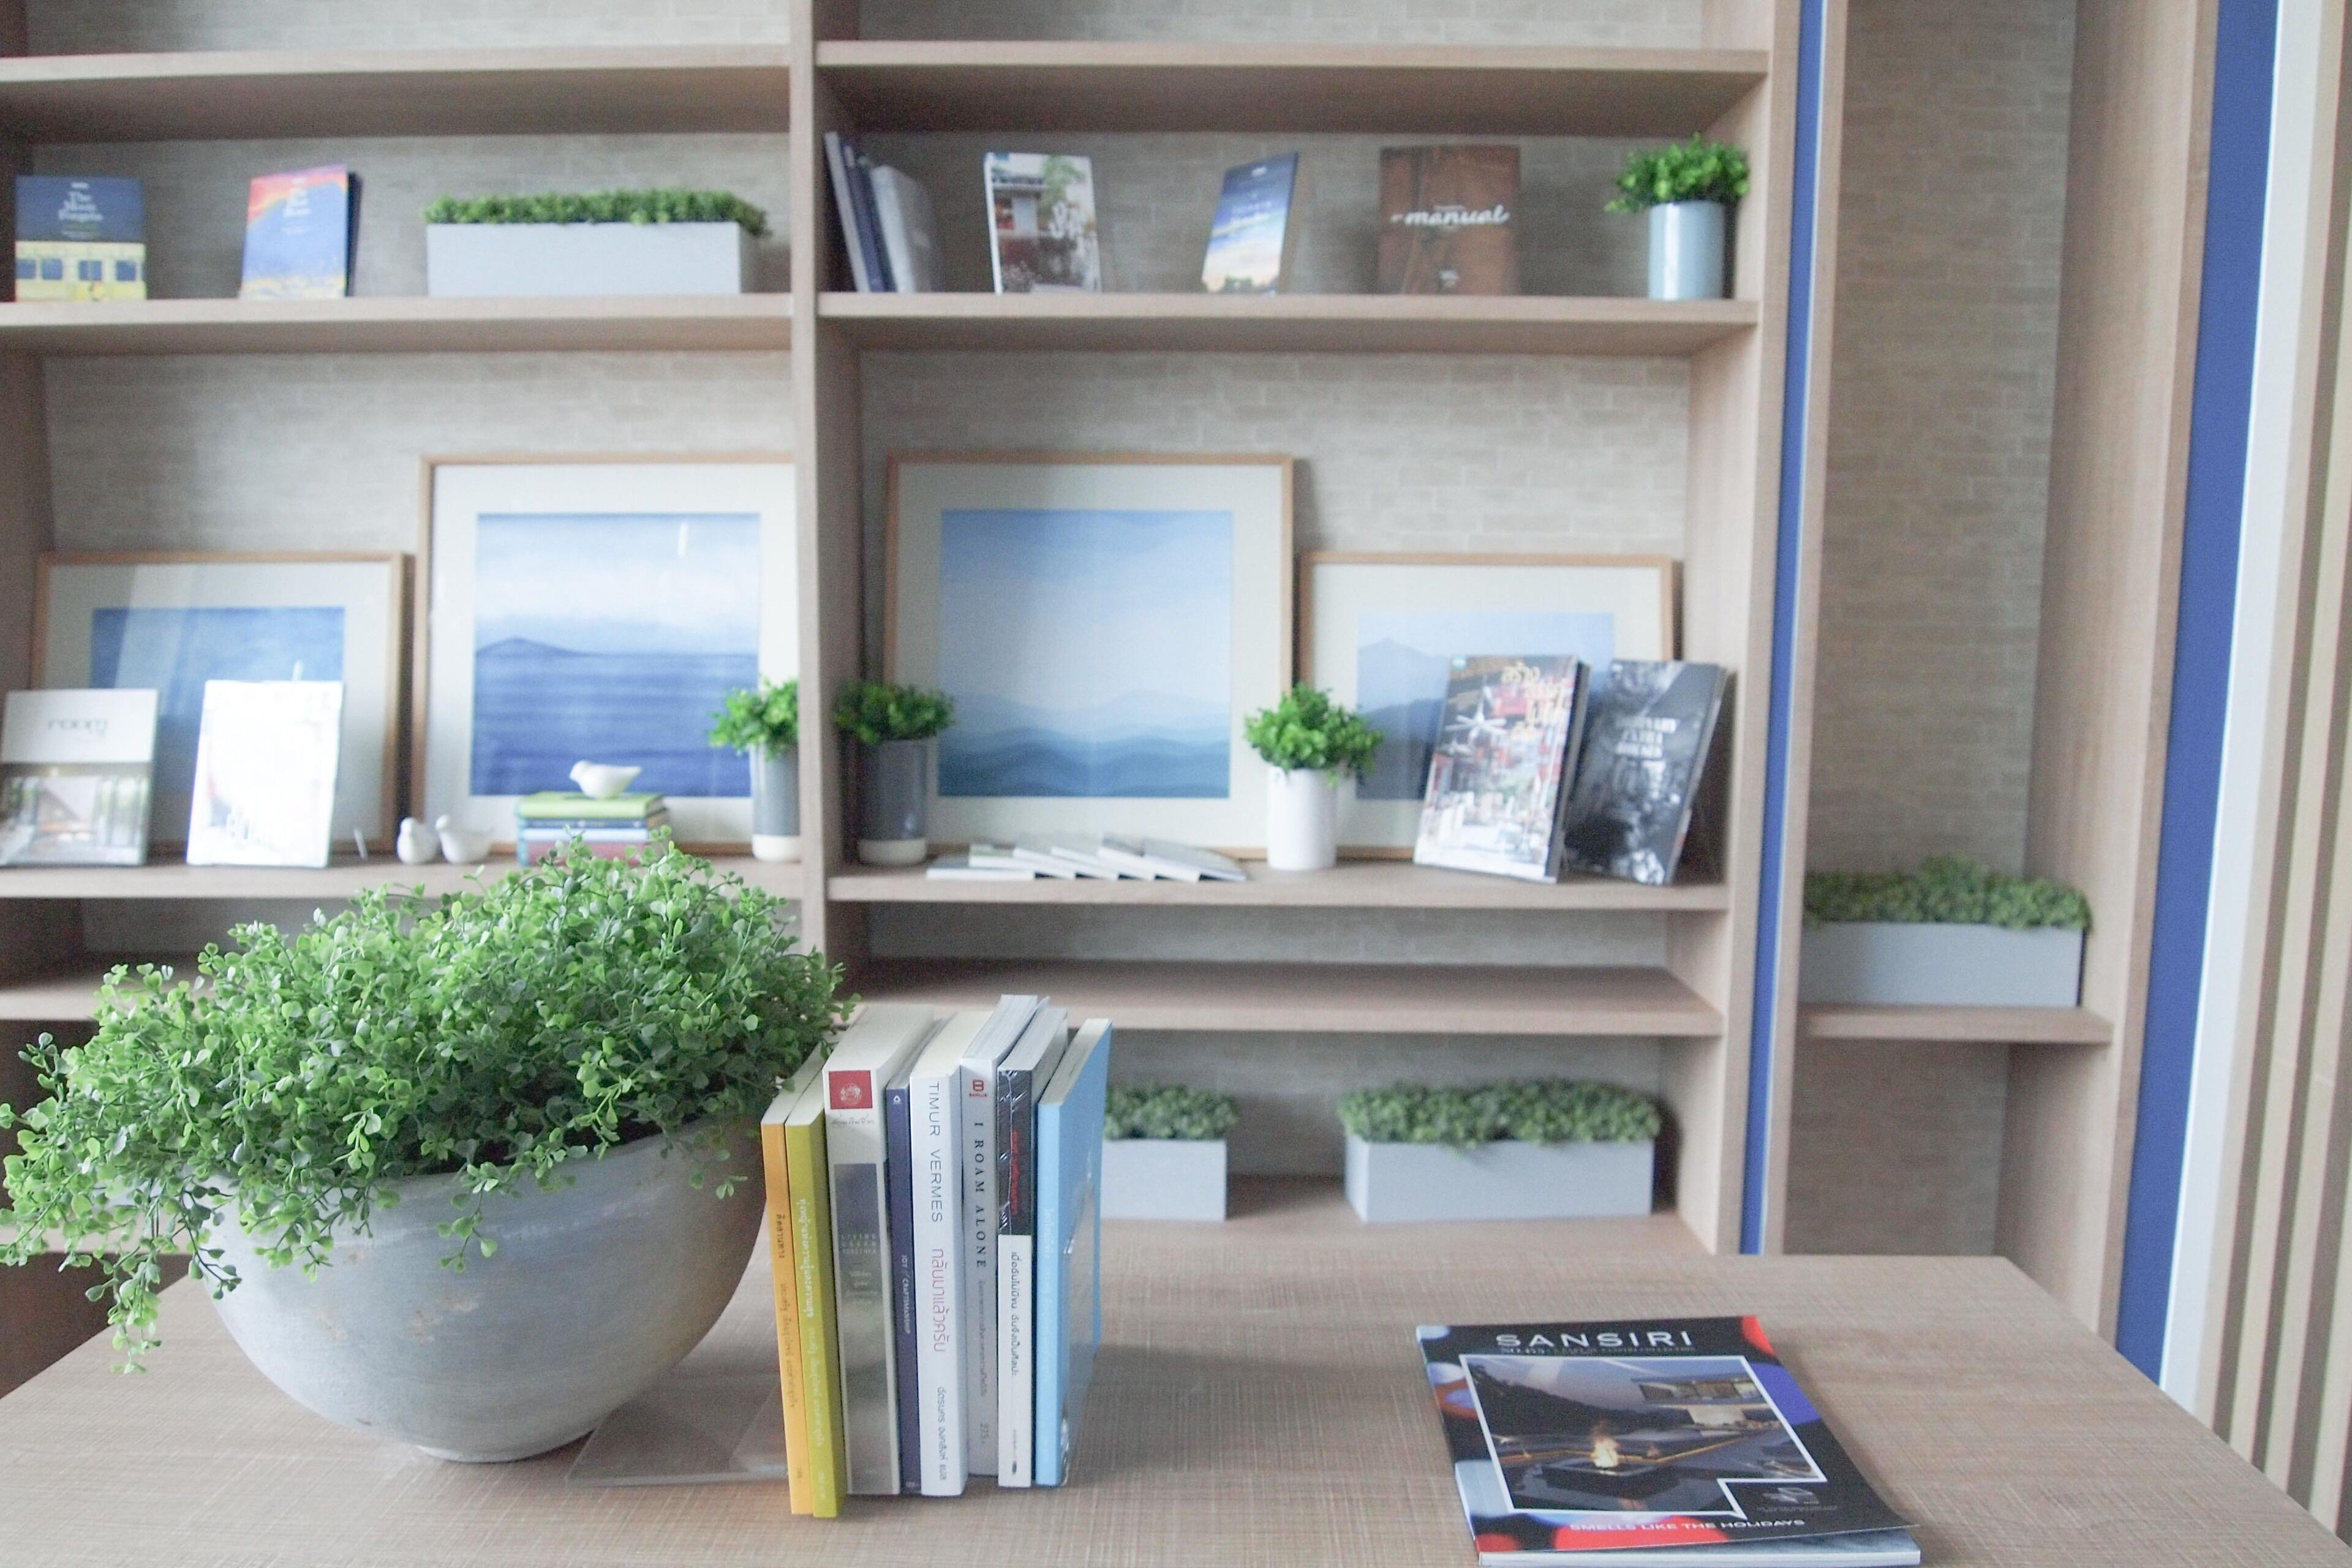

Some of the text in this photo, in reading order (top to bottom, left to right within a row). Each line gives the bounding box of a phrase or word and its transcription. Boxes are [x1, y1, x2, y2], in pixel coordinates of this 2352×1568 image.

[929, 1081, 942, 1223] TIMUR VERMES
[974, 1140, 984, 1193] ROAM
[976, 1205, 986, 1267] ALONE
[931, 1249, 949, 1352] กลับมาแล้วครับ
[1496, 1331, 1692, 1348] SANSIRI
[1721, 1520, 1805, 1528] HOLIDAYS
